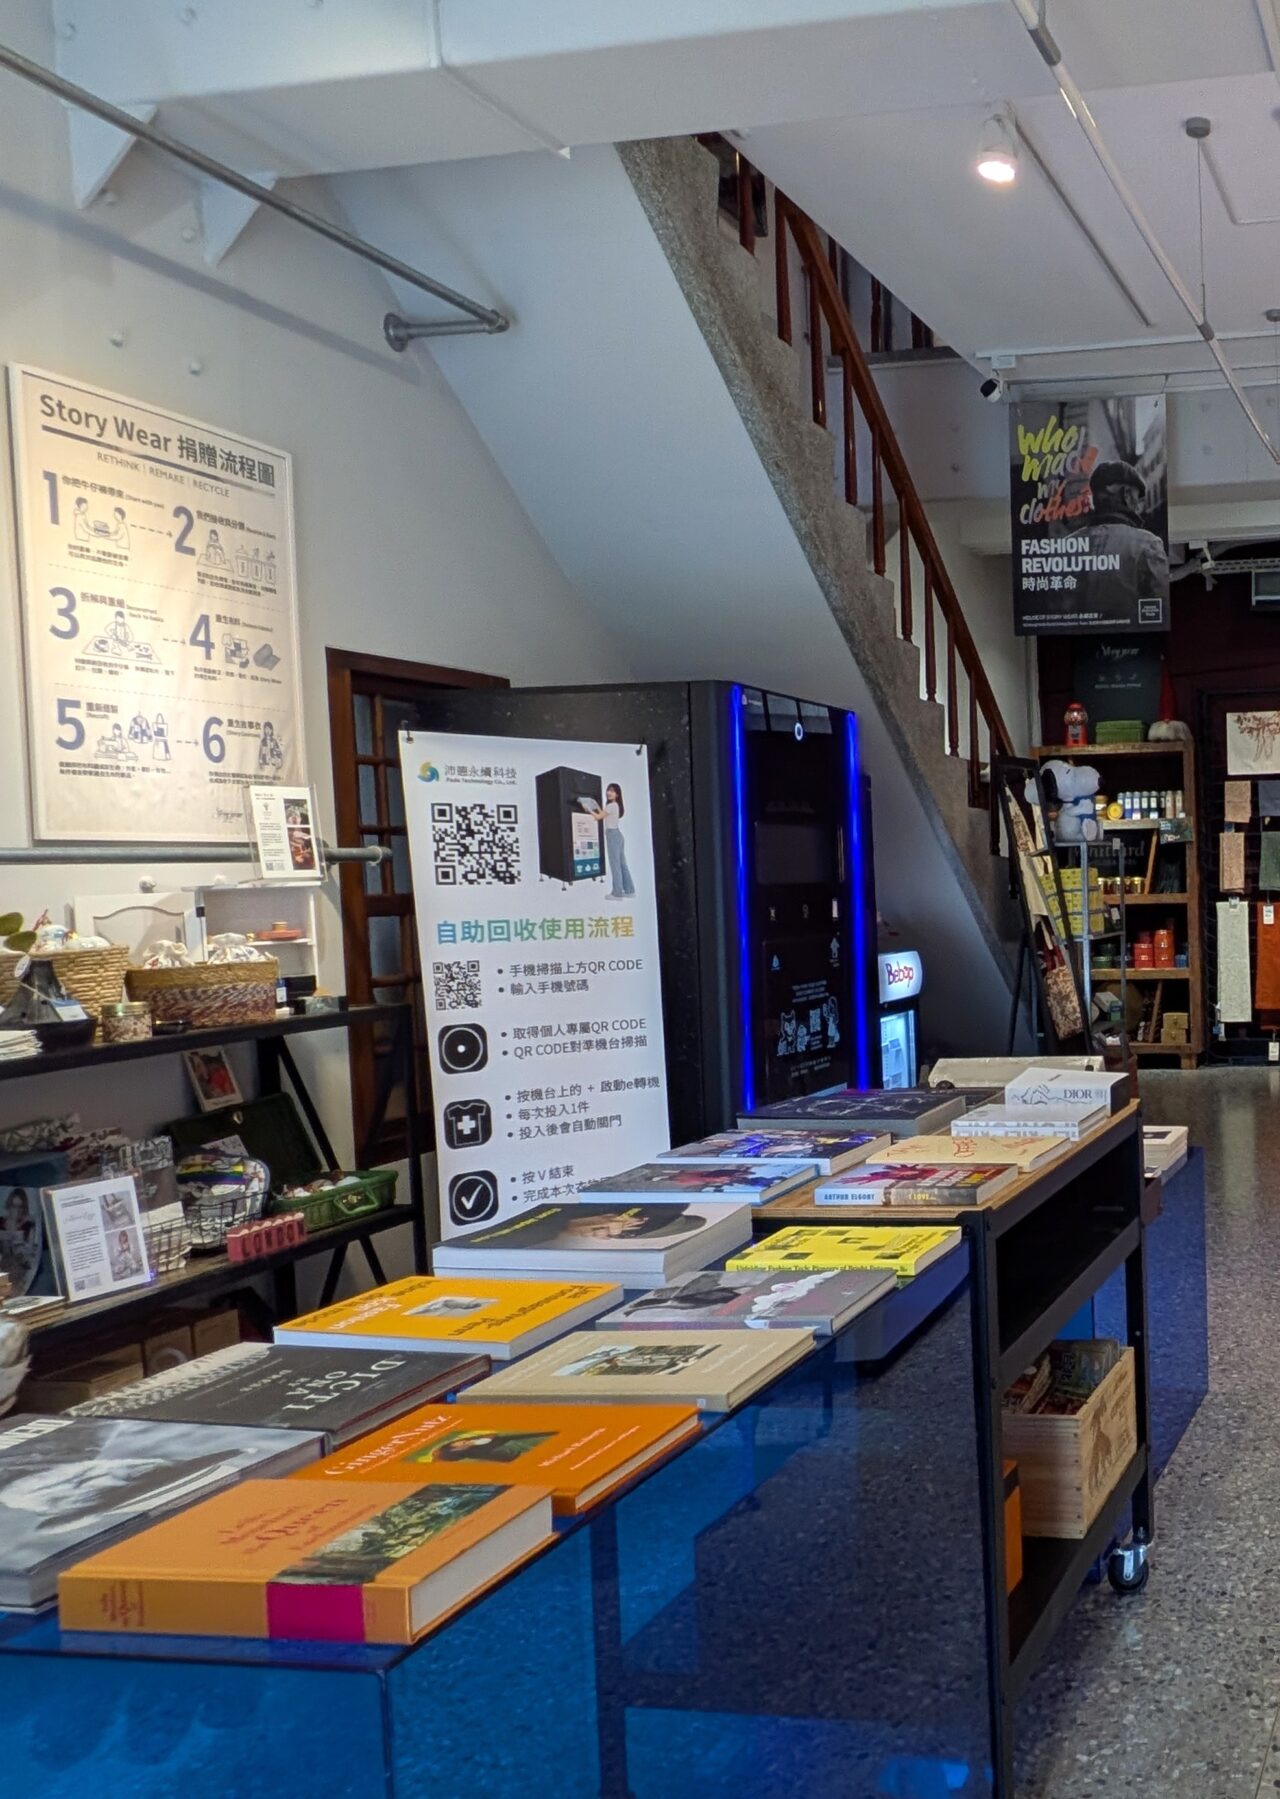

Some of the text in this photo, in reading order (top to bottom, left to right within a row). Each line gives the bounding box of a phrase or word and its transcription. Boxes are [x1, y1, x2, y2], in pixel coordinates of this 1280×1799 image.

[40, 394, 275, 488] Story Wear 捐贈流程圖
[97, 451, 230, 498] RETHINK REMAKE RECYCLE
[42, 470, 60, 525] 1
[173, 506, 196, 556] 2
[1021, 536, 1090, 555] FASHION
[1021, 554, 1120, 574] REVOLUTION
[1022, 575, 1077, 592] 時尚革命
[48, 587, 80, 640] 3
[189, 614, 215, 660] 4
[56, 698, 86, 751] 5
[202, 716, 226, 764] 6
[437, 916, 635, 945] 自助回收使用流程
[509, 959, 643, 978] 手機掃描上方QR CODE
[885, 960, 914, 988] Bebop
[510, 979, 589, 996] 輸入手機號碼
[513, 1018, 646, 1040] 取得個人專屬QR CODE
[513, 1047, 533, 1060] QR
[517, 1083, 582, 1104] 按機台上的
[1063, 1089, 1092, 1100] DIOR
[518, 1100, 590, 1121] 每次投入1件
[519, 1114, 622, 1140] 投入後會自動關門
[538, 1170, 546, 1180] V
[549, 1165, 574, 1180] 結束
[281, 1359, 407, 1410] DICTI
